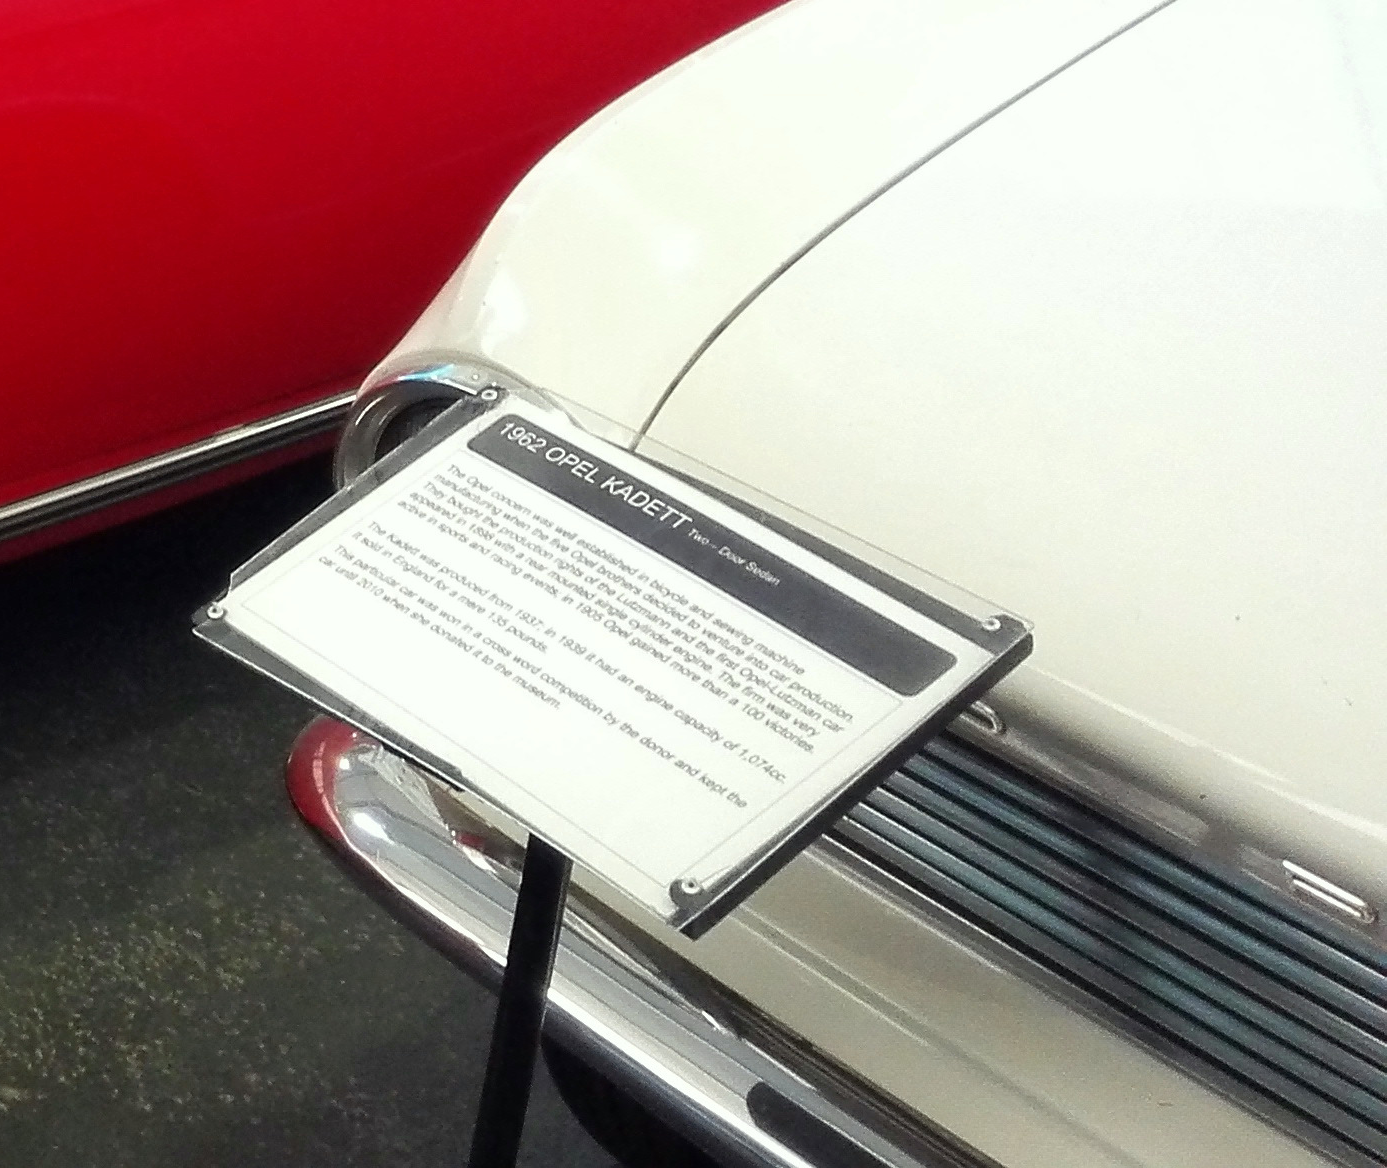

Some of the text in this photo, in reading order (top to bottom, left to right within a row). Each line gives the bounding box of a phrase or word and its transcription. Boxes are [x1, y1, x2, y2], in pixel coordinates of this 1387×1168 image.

[500, 422, 547, 453] 1962
[545, 446, 599, 484] OPEL
[600, 475, 693, 529] KADETT
[427, 622, 475, 653] donated
[491, 662, 515, 678] the
[485, 611, 510, 627] 135
[485, 593, 515, 612] from
[555, 636, 587, 657] 1939
[591, 658, 619, 677] had
[630, 682, 676, 713] engine
[670, 707, 726, 744] capacity
[522, 557, 547, 573] rear
[545, 569, 597, 601] mounted
[591, 597, 630, 622] single
[624, 617, 675, 649] cylinder
[715, 670, 743, 689] The
[739, 685, 768, 705] firm
[763, 701, 792, 720] was
[788, 717, 820, 739] very
[547, 537, 572, 553] five
[566, 549, 599, 570] Opel
[593, 564, 644, 596] brothers
[639, 591, 690, 622] decided
[699, 626, 747, 657] venture
[742, 652, 771, 671] into
[766, 668, 791, 684] car
[550, 556, 586, 579] rights
[594, 581, 618, 597] the
[614, 592, 674, 630] Lutzmann
[669, 625, 697, 644] and
[693, 639, 718, 656] the
[713, 652, 741, 670] first
[820, 717, 844, 734] car
[573, 602, 604, 623] 1905
[598, 618, 633, 641] Opel
[626, 635, 672, 665] gained
[667, 660, 702, 683] more
[699, 678, 731, 700] than
[738, 703, 766, 721] 100
[574, 536, 639, 576] established
[645, 579, 691, 607] bicycle
[687, 602, 715, 620] and
[709, 616, 757, 646] sewing
[752, 641, 807, 676] machine
[479, 636, 512, 658] cross
[509, 653, 542, 675] word
[535, 671, 606, 717] competition
[617, 721, 642, 739] the
[637, 734, 677, 761] donor
[672, 756, 702, 777] and
[695, 772, 730, 796] kept
[725, 790, 751, 809] the
